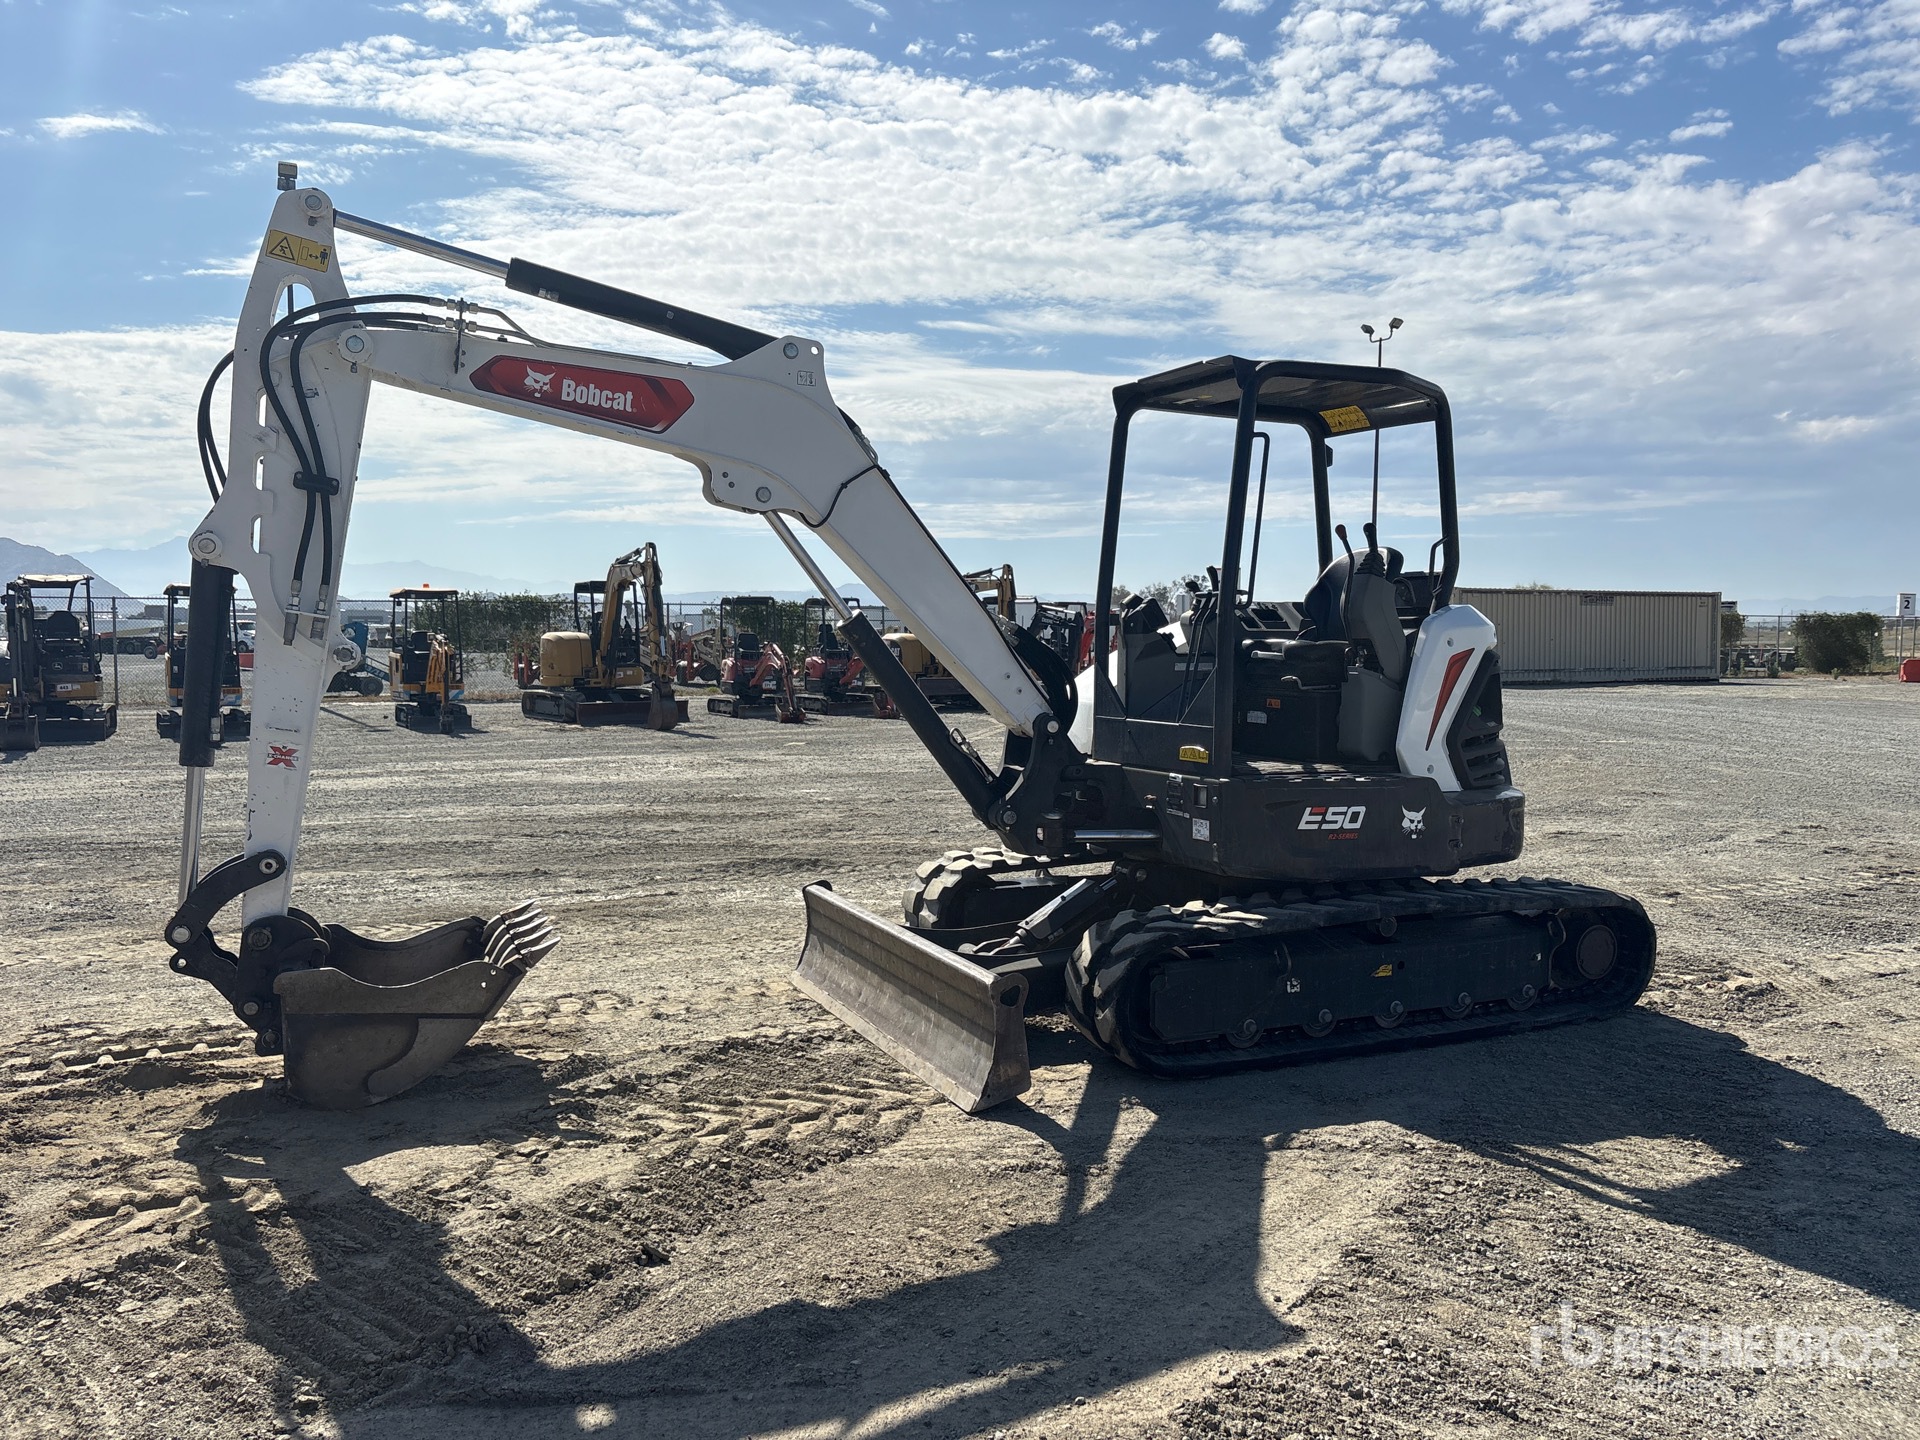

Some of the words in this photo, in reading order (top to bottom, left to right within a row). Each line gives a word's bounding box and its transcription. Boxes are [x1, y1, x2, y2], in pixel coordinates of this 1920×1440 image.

[561, 379, 633, 412] Bobcat
[1904, 600, 1910, 609] 2
[1297, 805, 1367, 830] E50
